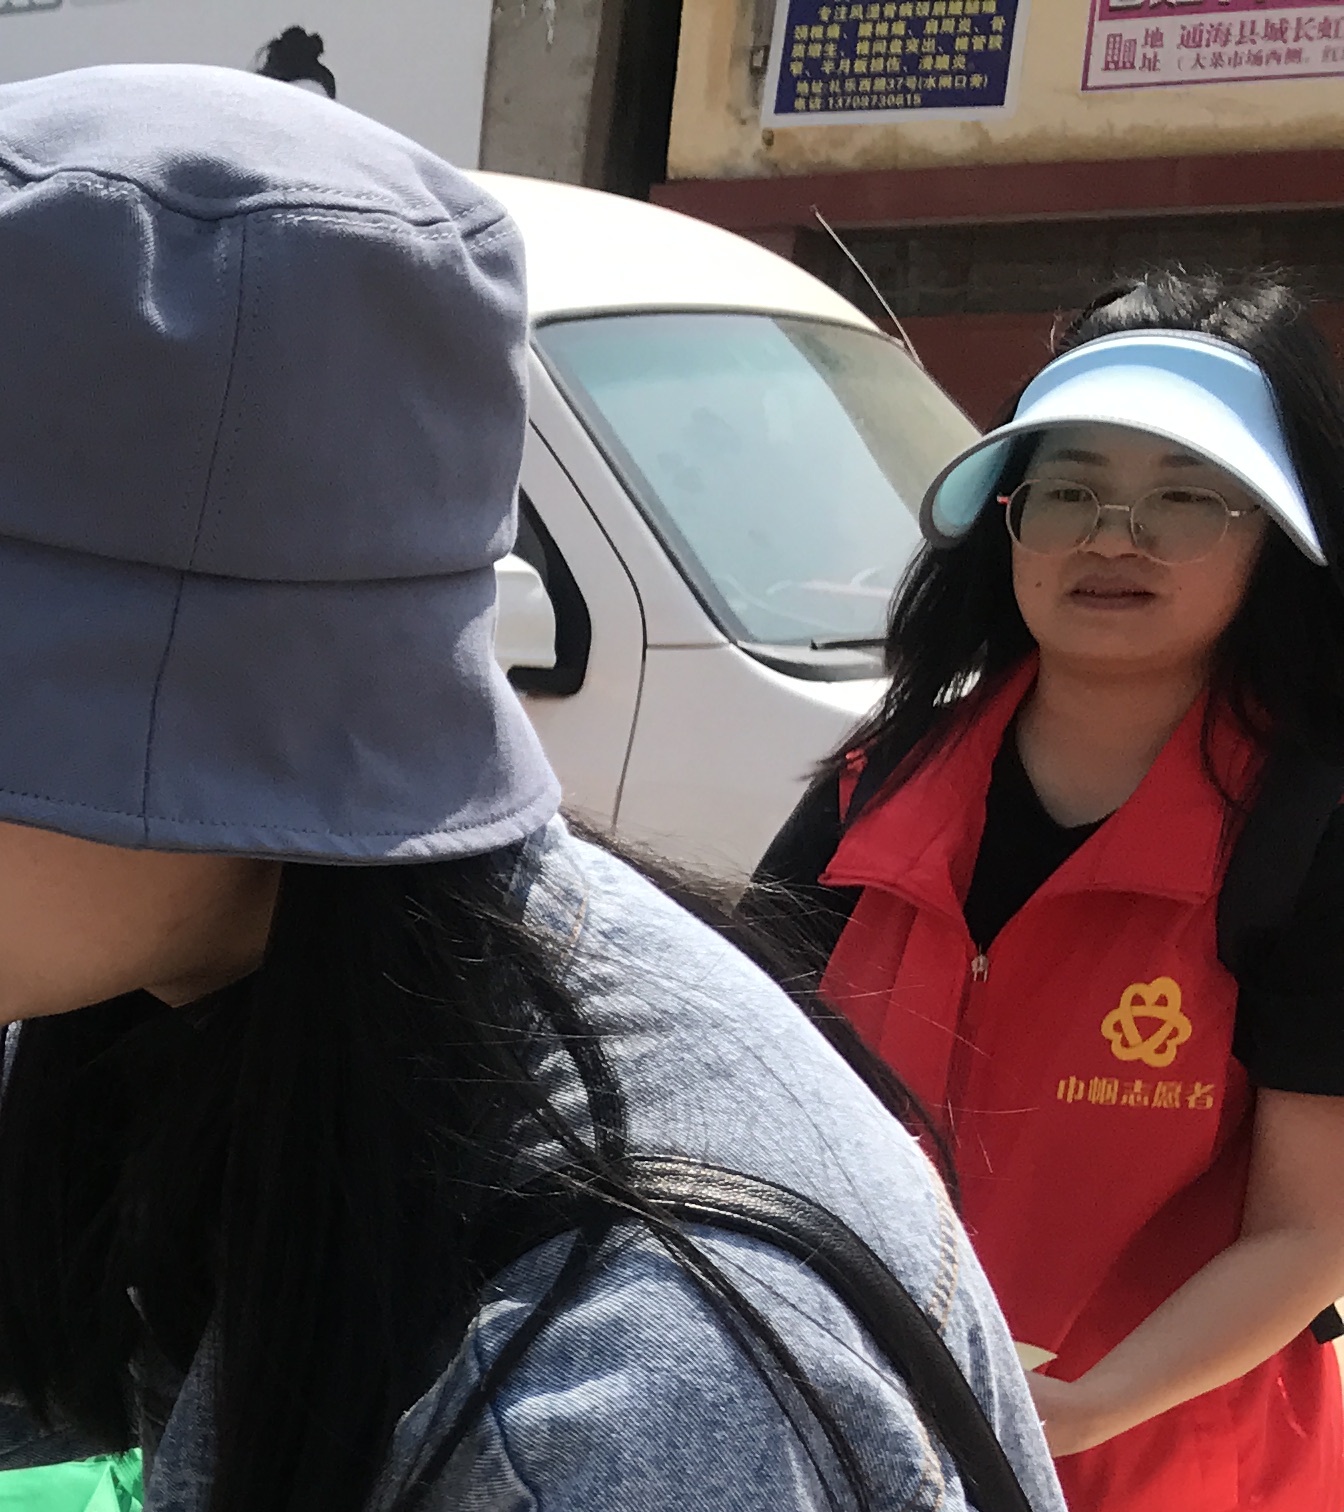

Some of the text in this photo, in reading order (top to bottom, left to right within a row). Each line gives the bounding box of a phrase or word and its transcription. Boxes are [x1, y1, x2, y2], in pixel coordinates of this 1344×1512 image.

[1057, 1075, 1215, 1110] 巾帼志愿者
